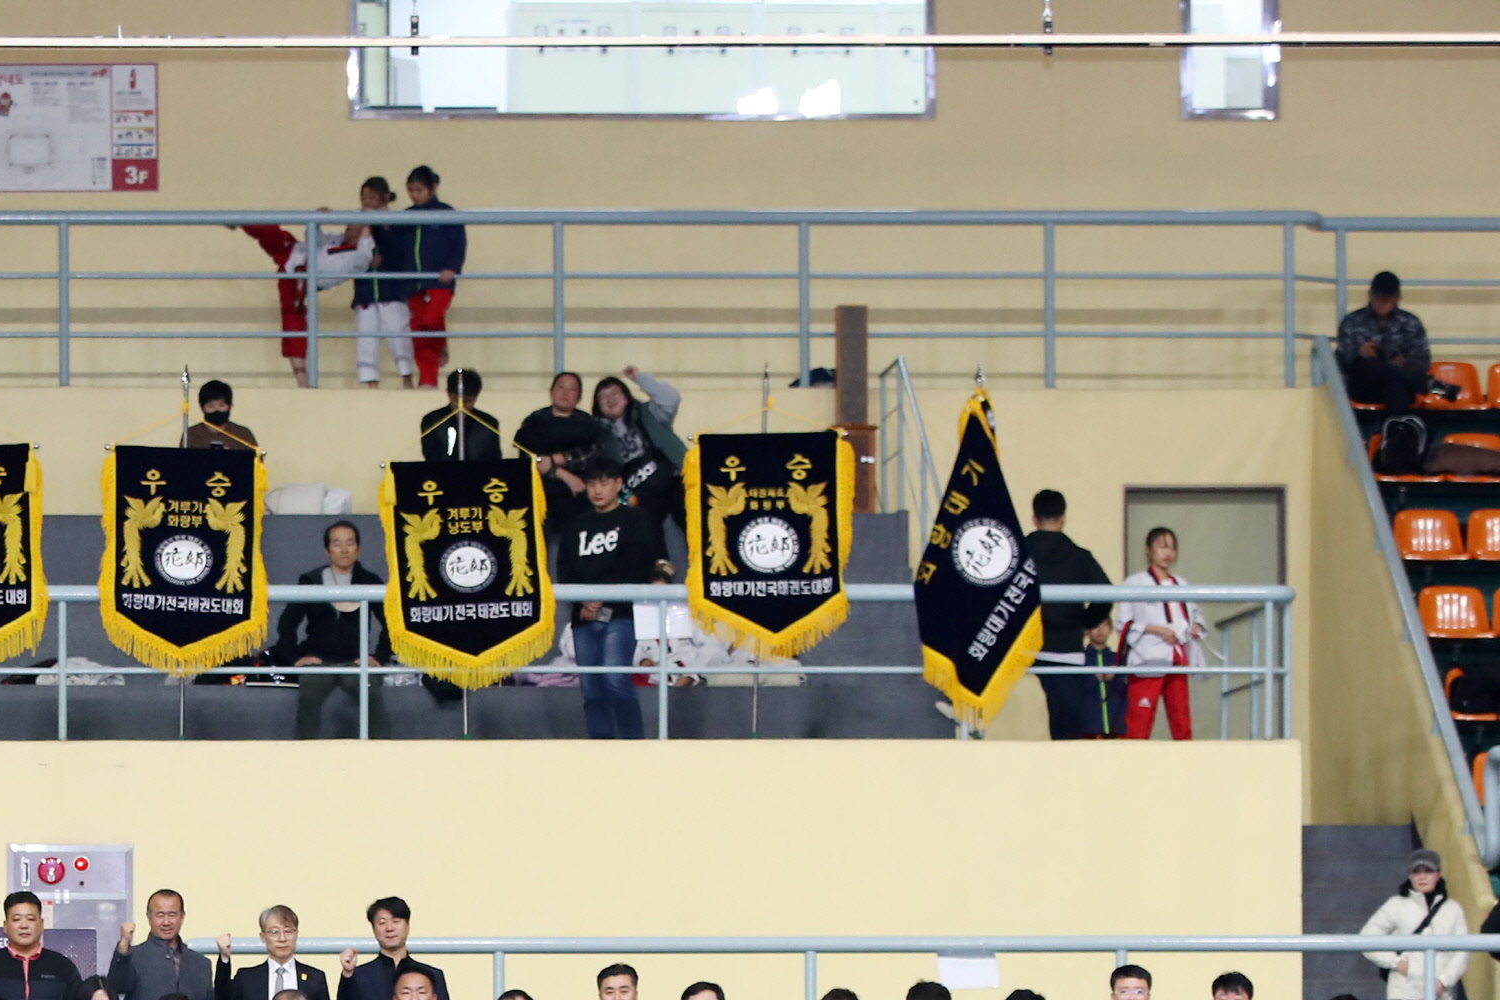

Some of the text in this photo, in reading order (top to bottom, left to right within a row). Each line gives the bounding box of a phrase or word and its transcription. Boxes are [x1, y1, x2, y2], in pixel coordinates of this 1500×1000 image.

[124, 166, 149, 185] 3F
[167, 499, 204, 515] 겨루기
[446, 507, 483, 521] 겨루기
[167, 514, 204, 529] 화랑부
[447, 521, 484, 535] 낭도부
[578, 529, 619, 557] Lee
